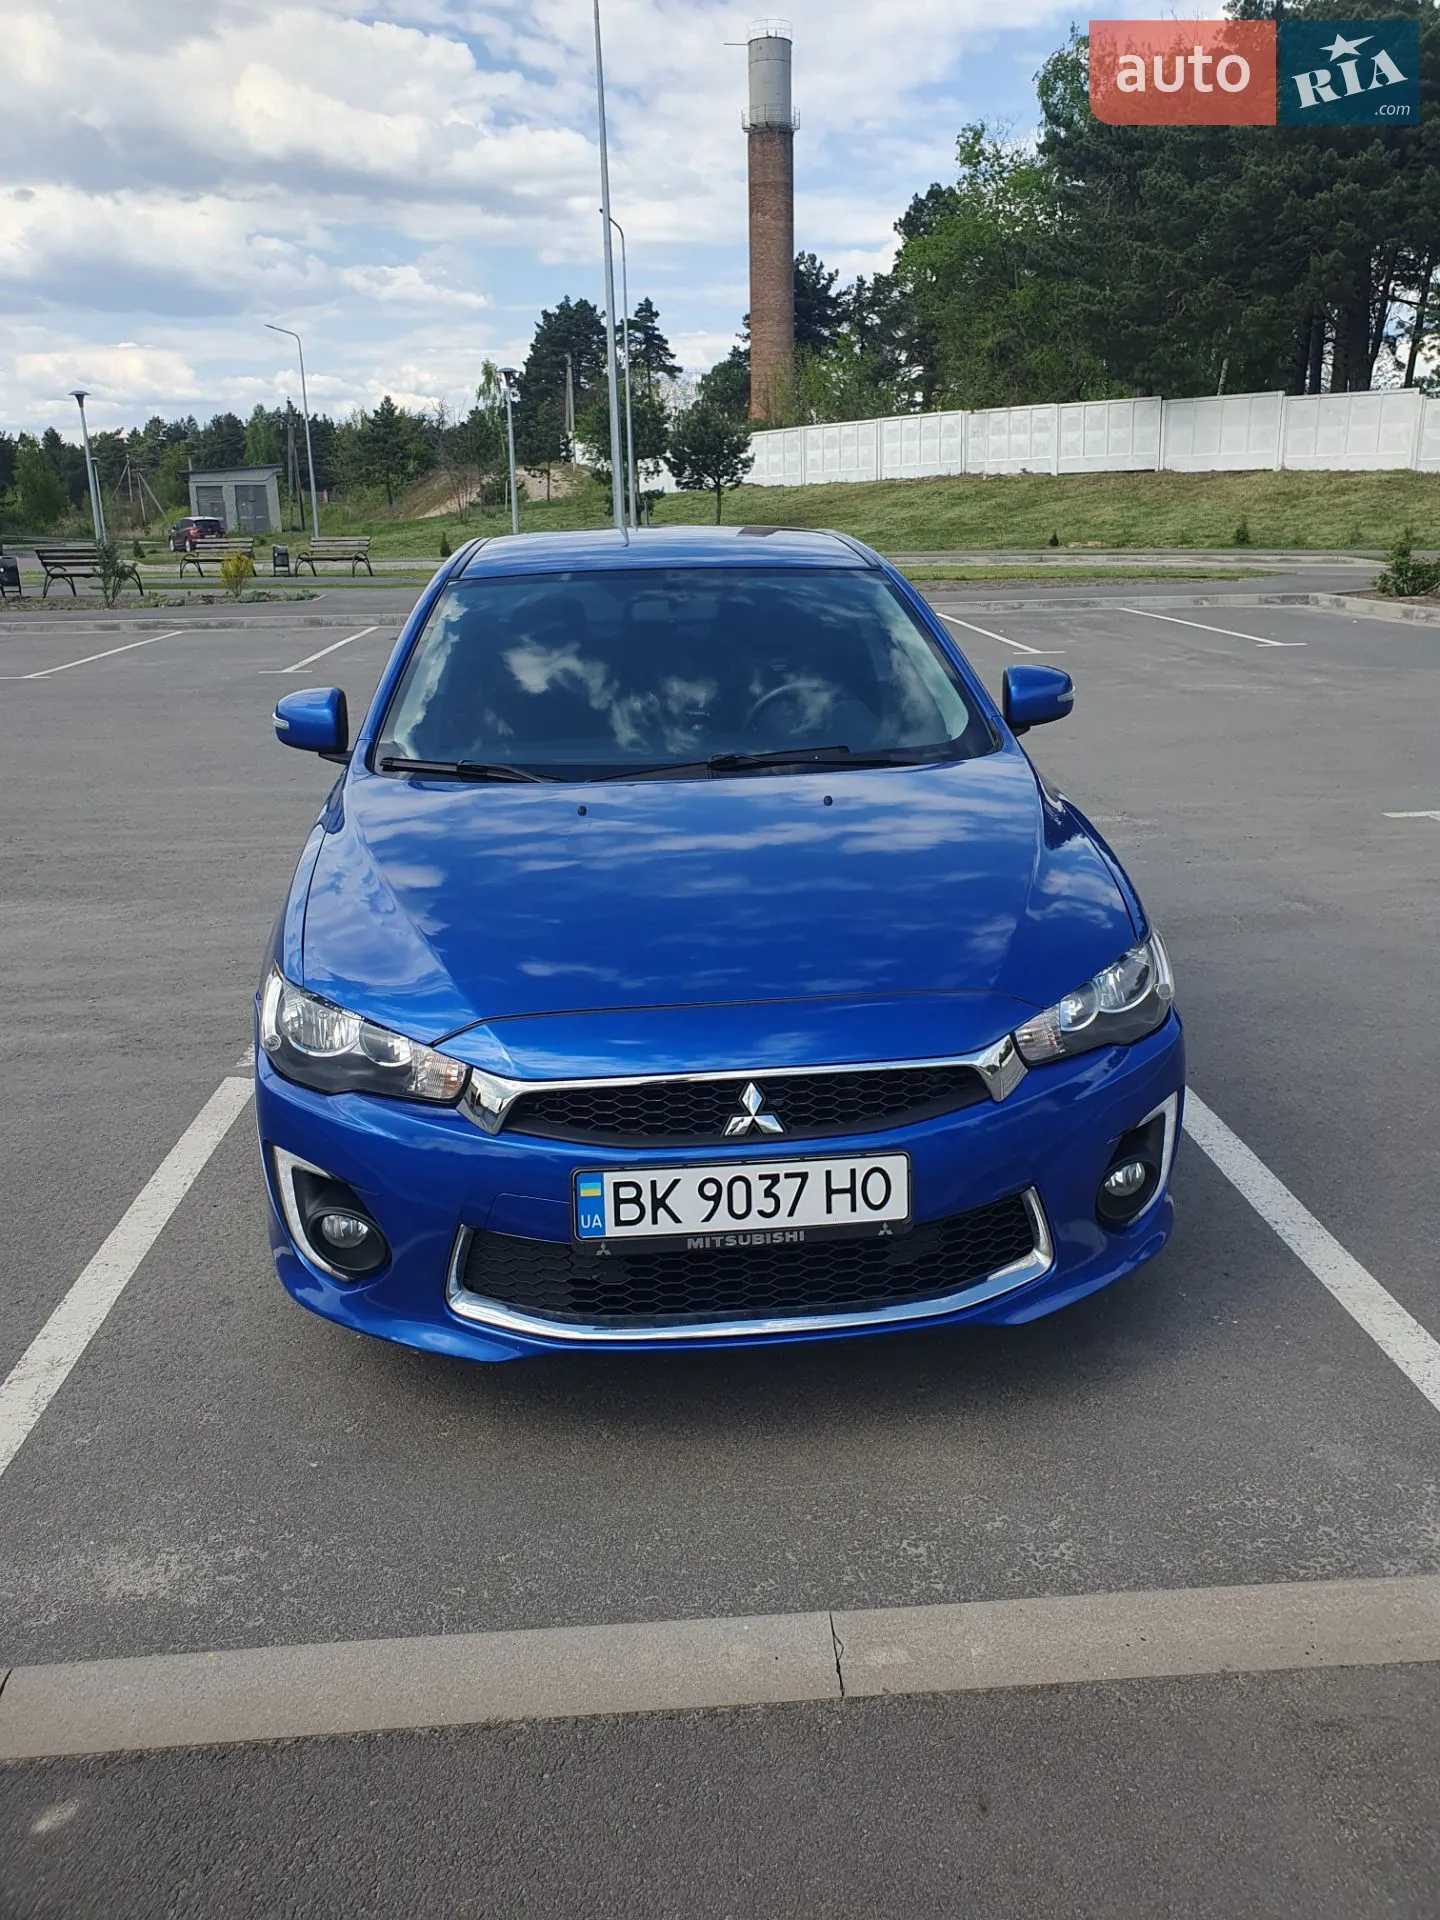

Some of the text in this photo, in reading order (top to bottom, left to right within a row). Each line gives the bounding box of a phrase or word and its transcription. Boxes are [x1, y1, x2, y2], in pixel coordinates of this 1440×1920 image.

[612, 1166, 892, 1227] BK 9037 HO
[580, 1214, 602, 1229] UA
[687, 1230, 805, 1250] MITSUBISHI
